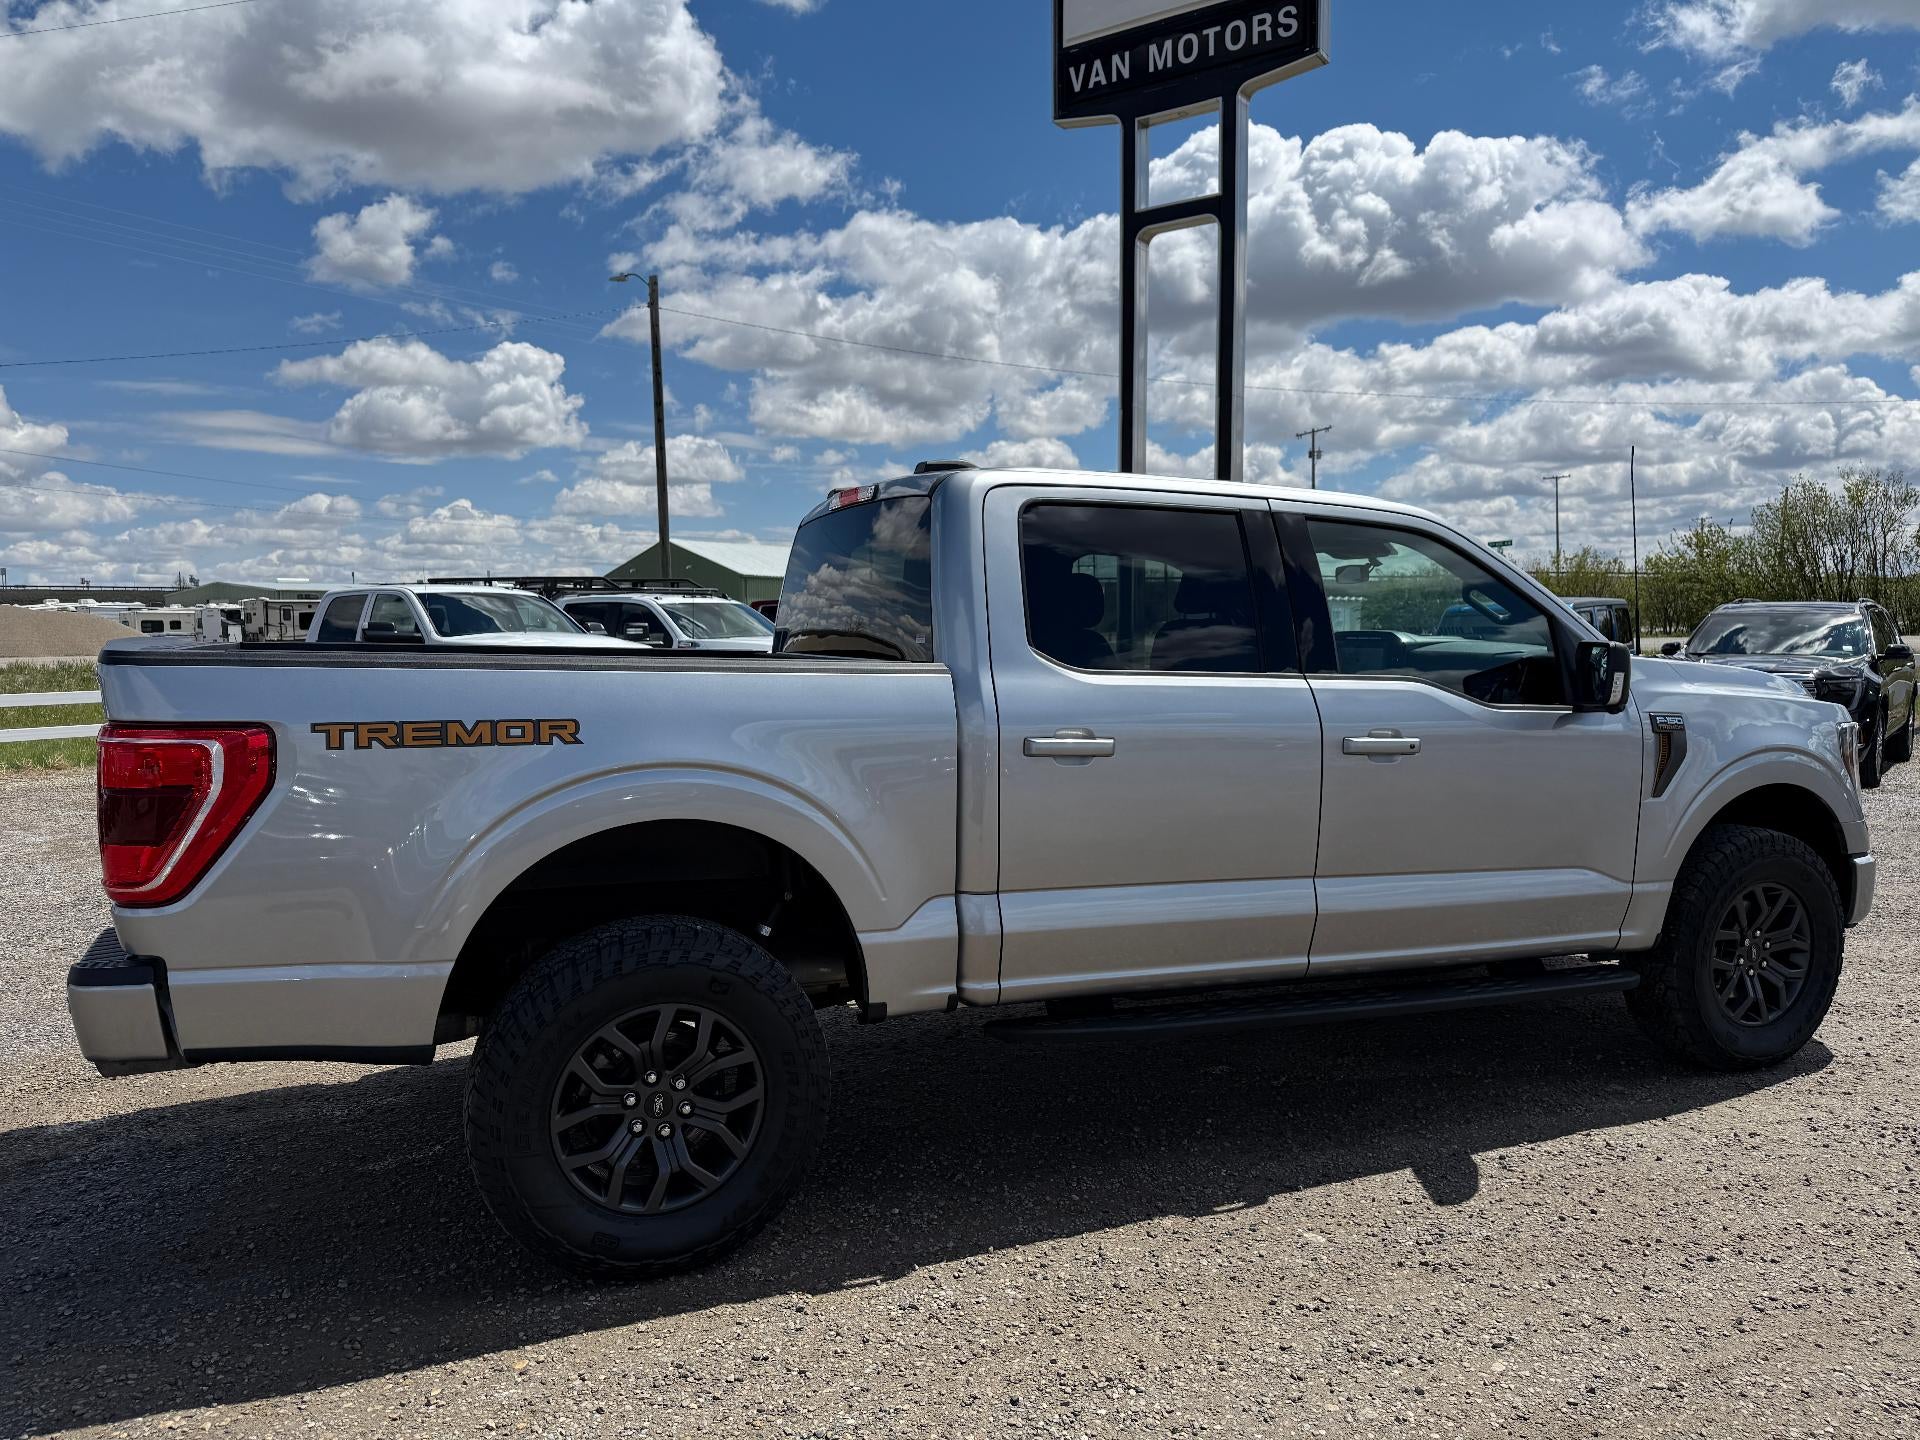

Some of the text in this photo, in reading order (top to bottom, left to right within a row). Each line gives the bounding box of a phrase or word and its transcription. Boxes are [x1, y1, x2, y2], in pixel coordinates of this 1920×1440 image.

[1068, 5, 1299, 93] VAN MOTORS
[310, 718, 585, 751] TREMOR
